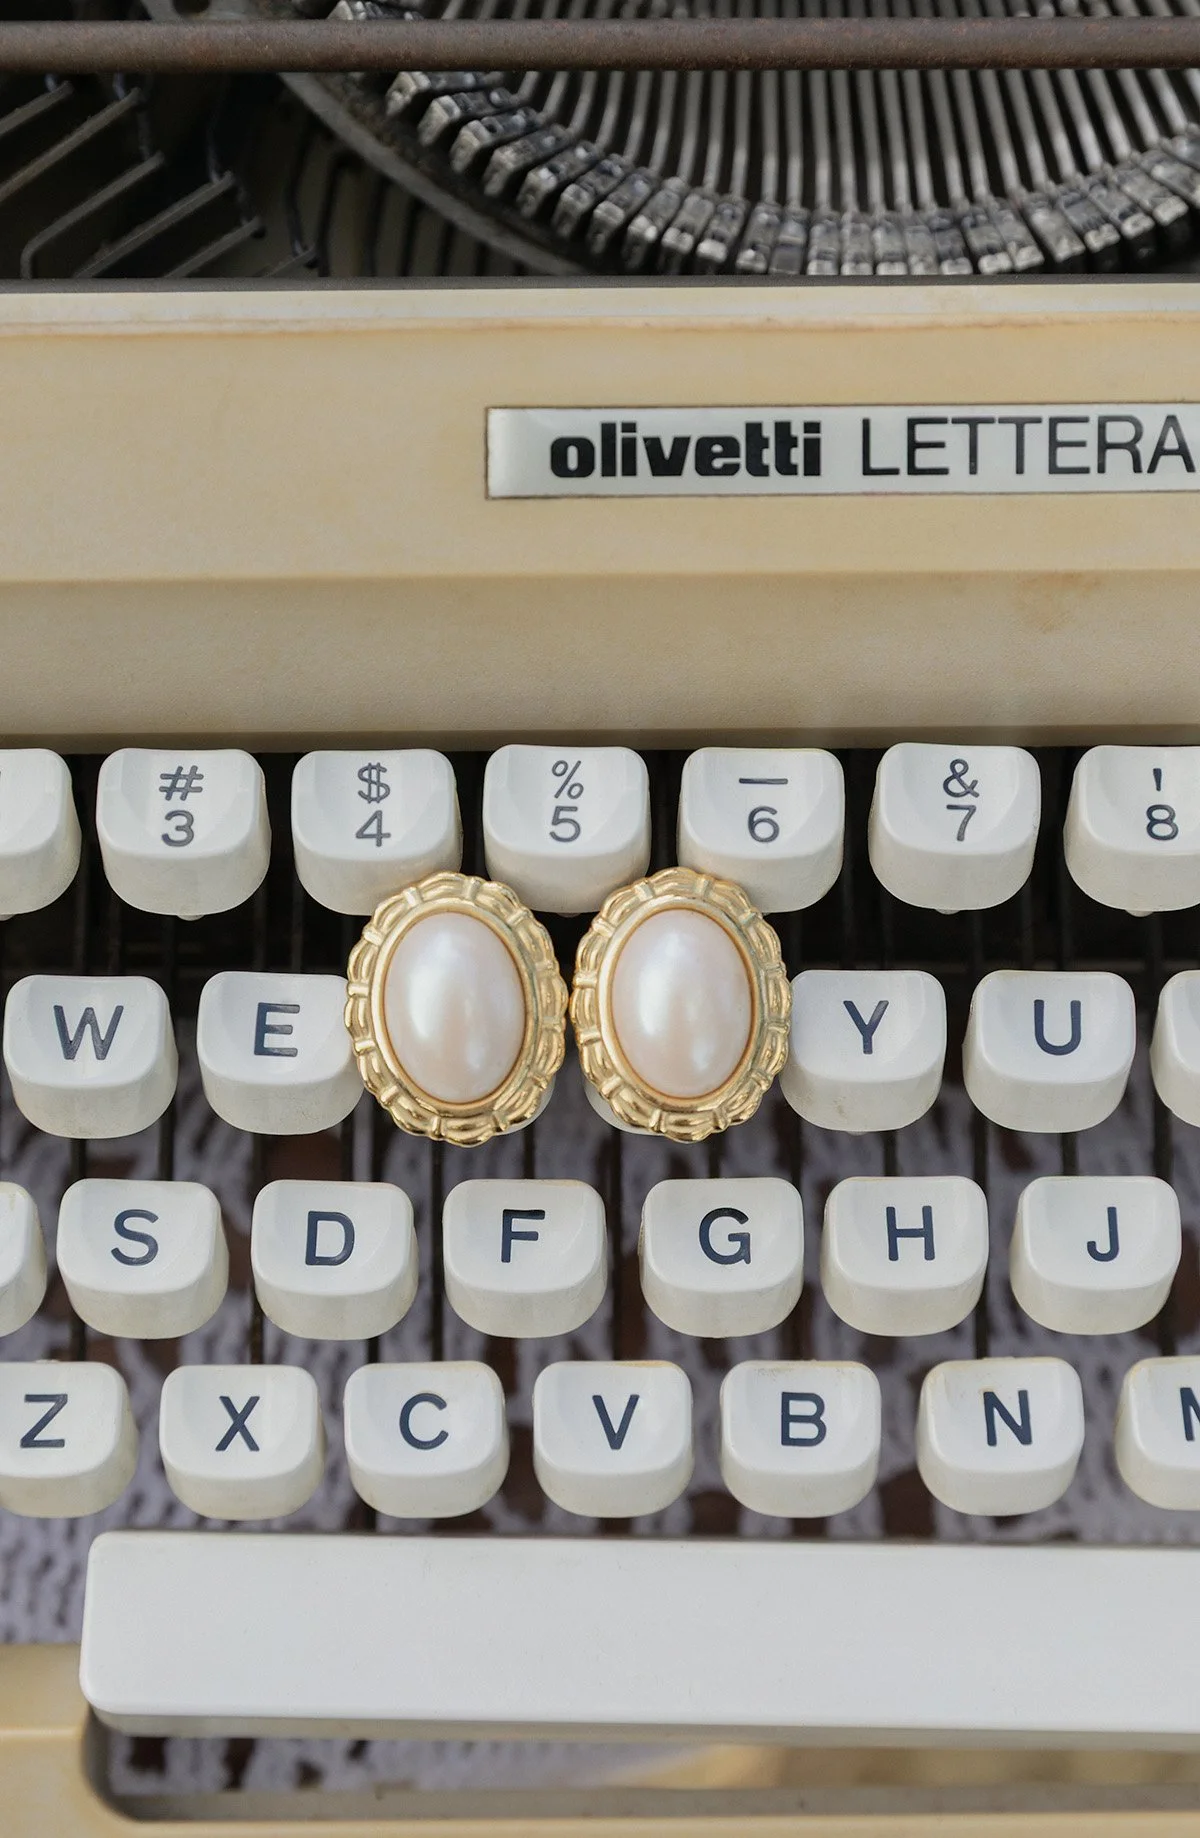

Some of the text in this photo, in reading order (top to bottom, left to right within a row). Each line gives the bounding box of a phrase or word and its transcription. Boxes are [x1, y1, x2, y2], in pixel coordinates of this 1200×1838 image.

[550, 414, 1197, 478] olivetti LETTERA
[159, 766, 204, 801] #
[358, 762, 391, 804] $
[552, 761, 584, 800] %
[943, 759, 980, 798] &
[162, 809, 195, 846] 3
[356, 811, 391, 848] 4
[550, 806, 581, 843] 5
[748, 806, 780, 843] 6
[947, 805, 977, 842] 7
[1146, 804, 1179, 842] 8
[53, 1005, 125, 1060] W
[254, 1002, 301, 1058] E
[843, 1001, 890, 1055] Y
[1034, 999, 1082, 1056] U
[111, 1209, 159, 1266] S
[305, 1211, 356, 1267] D
[501, 1209, 546, 1264] F
[699, 1208, 752, 1266] G
[886, 1206, 936, 1262] H
[1087, 1207, 1120, 1263] J
[20, 1394, 68, 1449] Z
[216, 1396, 261, 1452] X
[399, 1393, 449, 1451] C
[592, 1394, 640, 1451] V
[781, 1392, 827, 1447] B
[983, 1390, 1033, 1447] N
